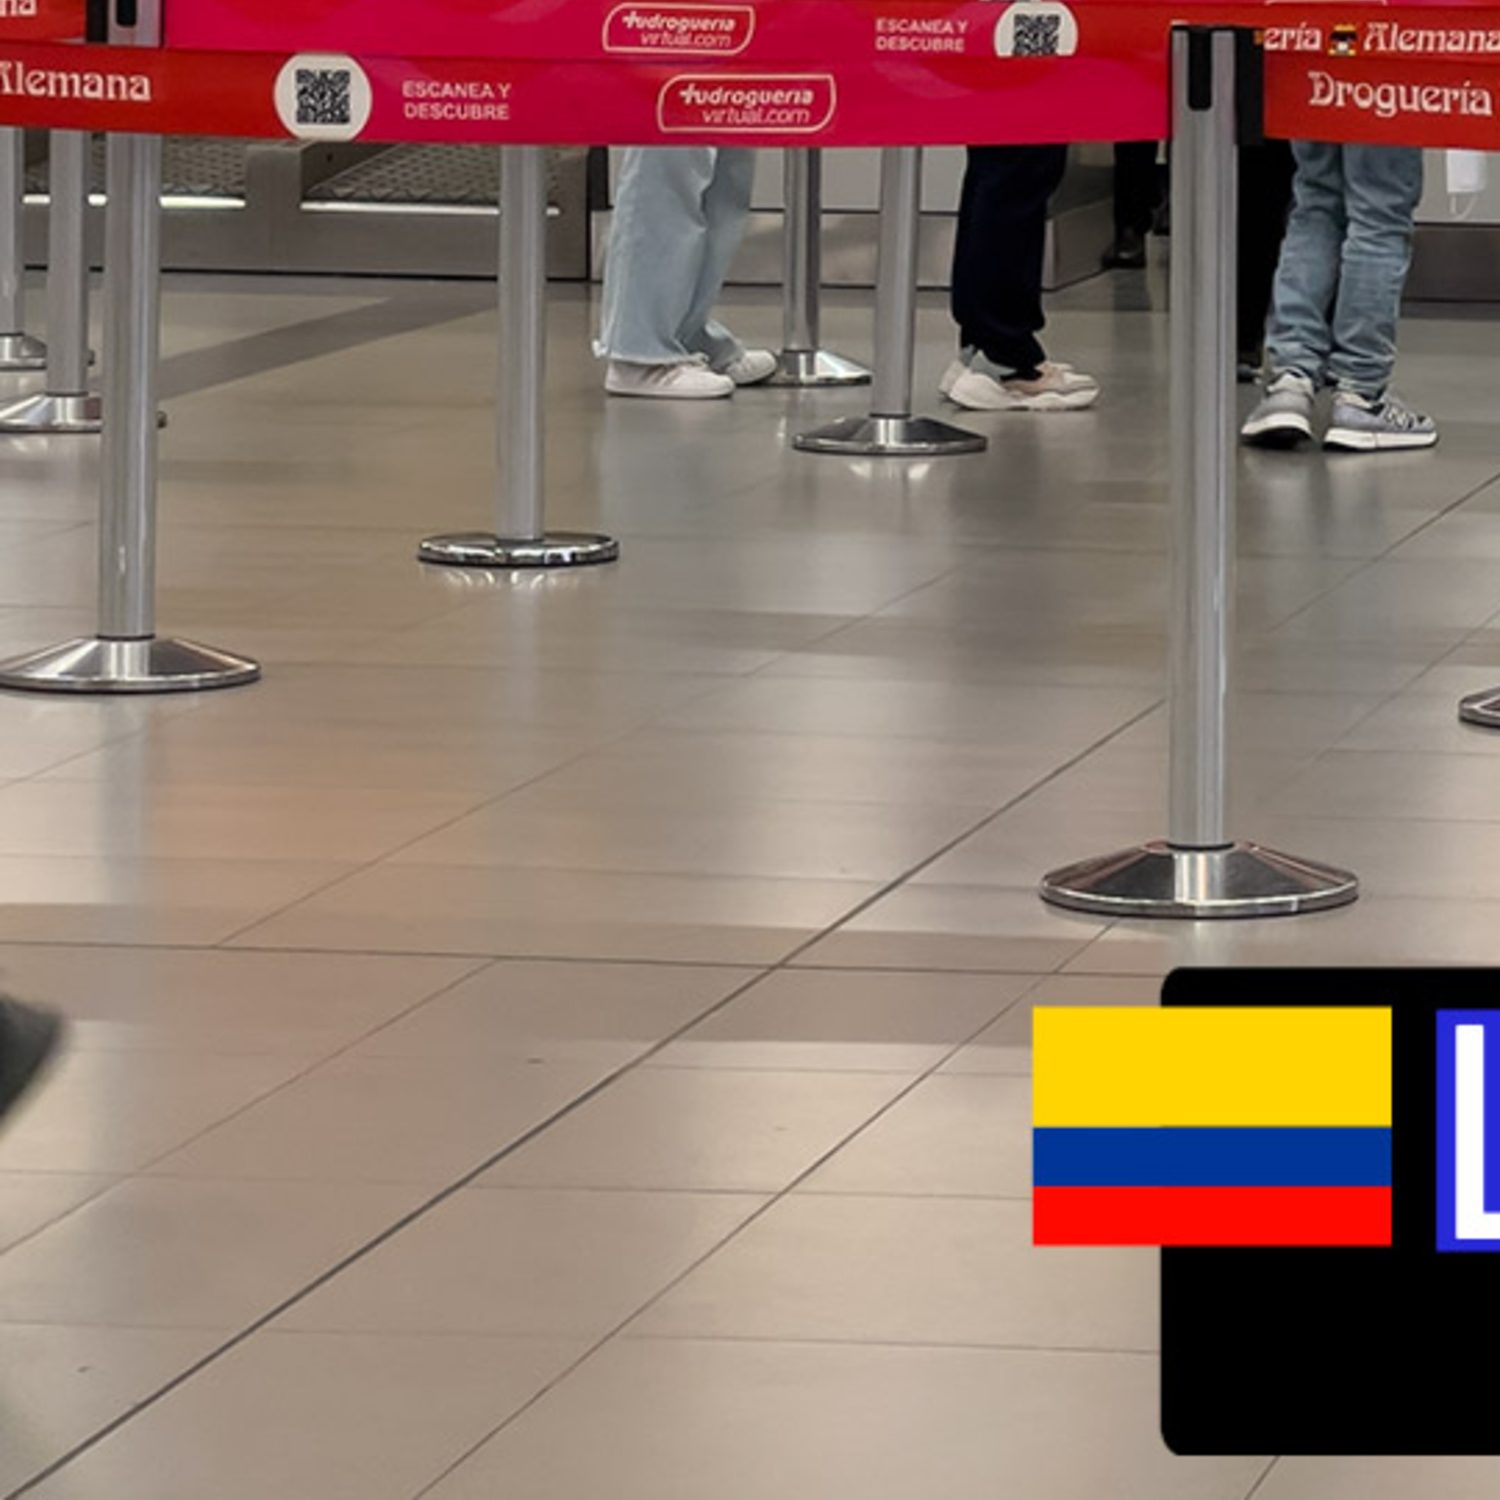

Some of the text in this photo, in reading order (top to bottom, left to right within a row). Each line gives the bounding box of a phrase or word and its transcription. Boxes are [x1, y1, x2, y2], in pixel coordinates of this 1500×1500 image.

[875, 18, 969, 35] ESCANEA Y
[875, 34, 965, 52] DESCUBRE
[402, 80, 512, 99] ESCANEA Y
[1307, 70, 1494, 117] Droguería
[403, 102, 511, 120] DESCUBRE
